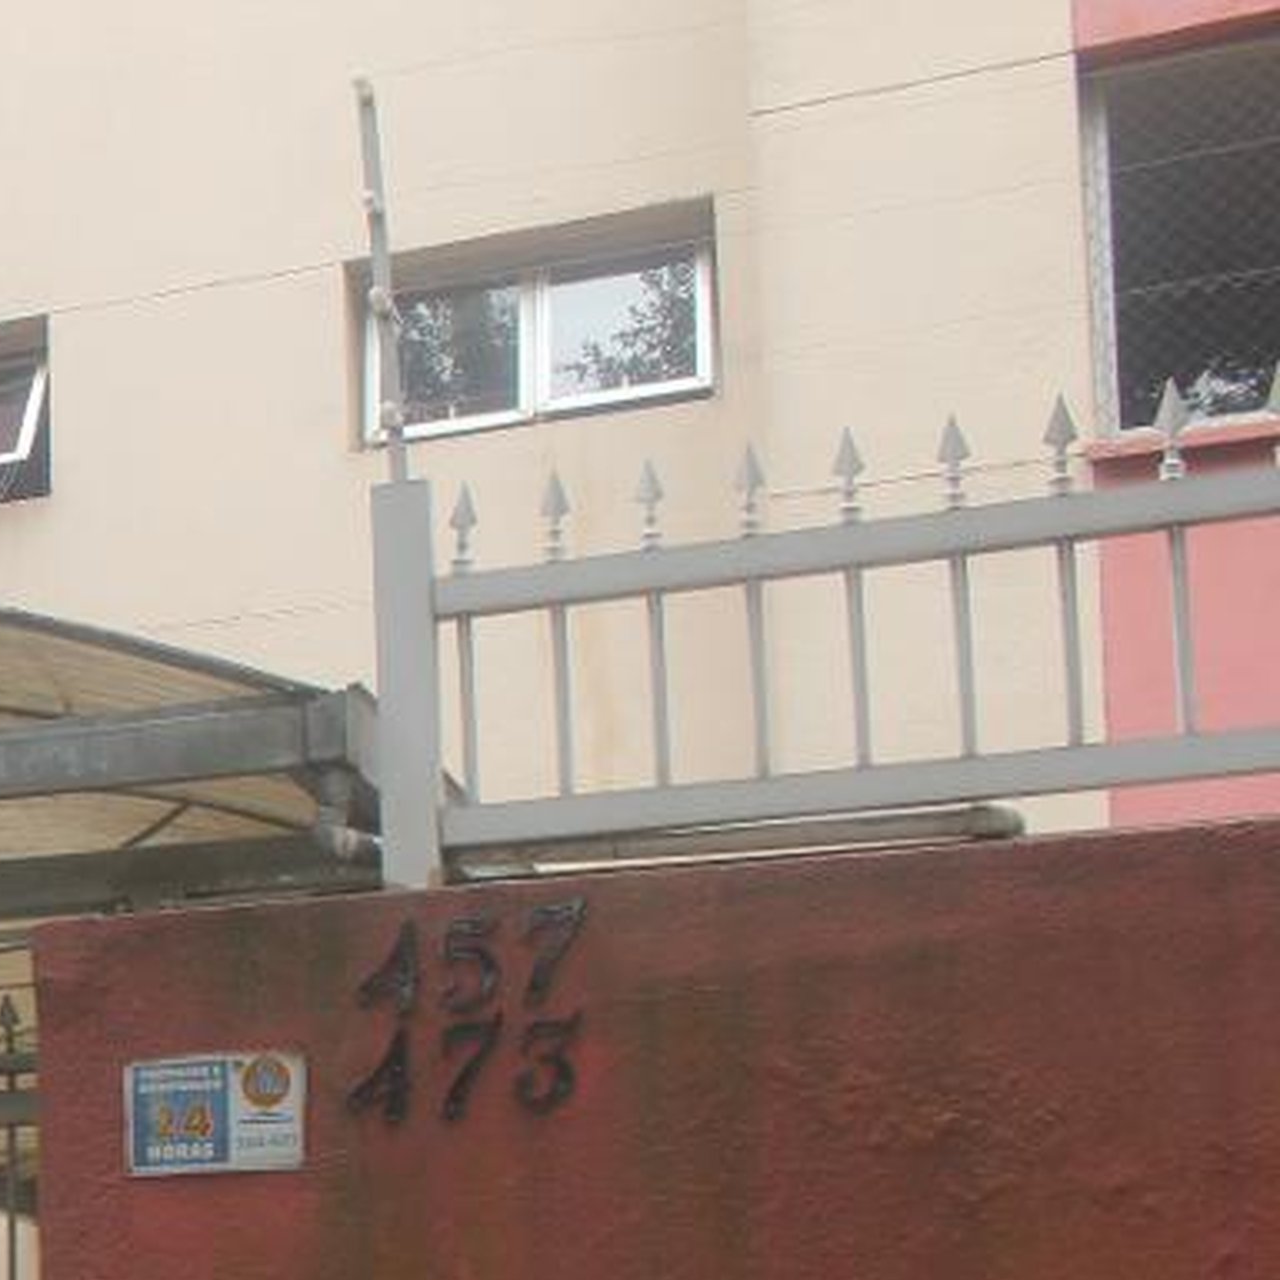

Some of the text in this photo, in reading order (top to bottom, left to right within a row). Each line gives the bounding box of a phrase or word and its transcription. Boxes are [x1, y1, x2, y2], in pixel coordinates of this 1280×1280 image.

[356, 897, 587, 1020] 157
[347, 1008, 584, 1126] 173
[146, 1142, 215, 1162] HORAS
